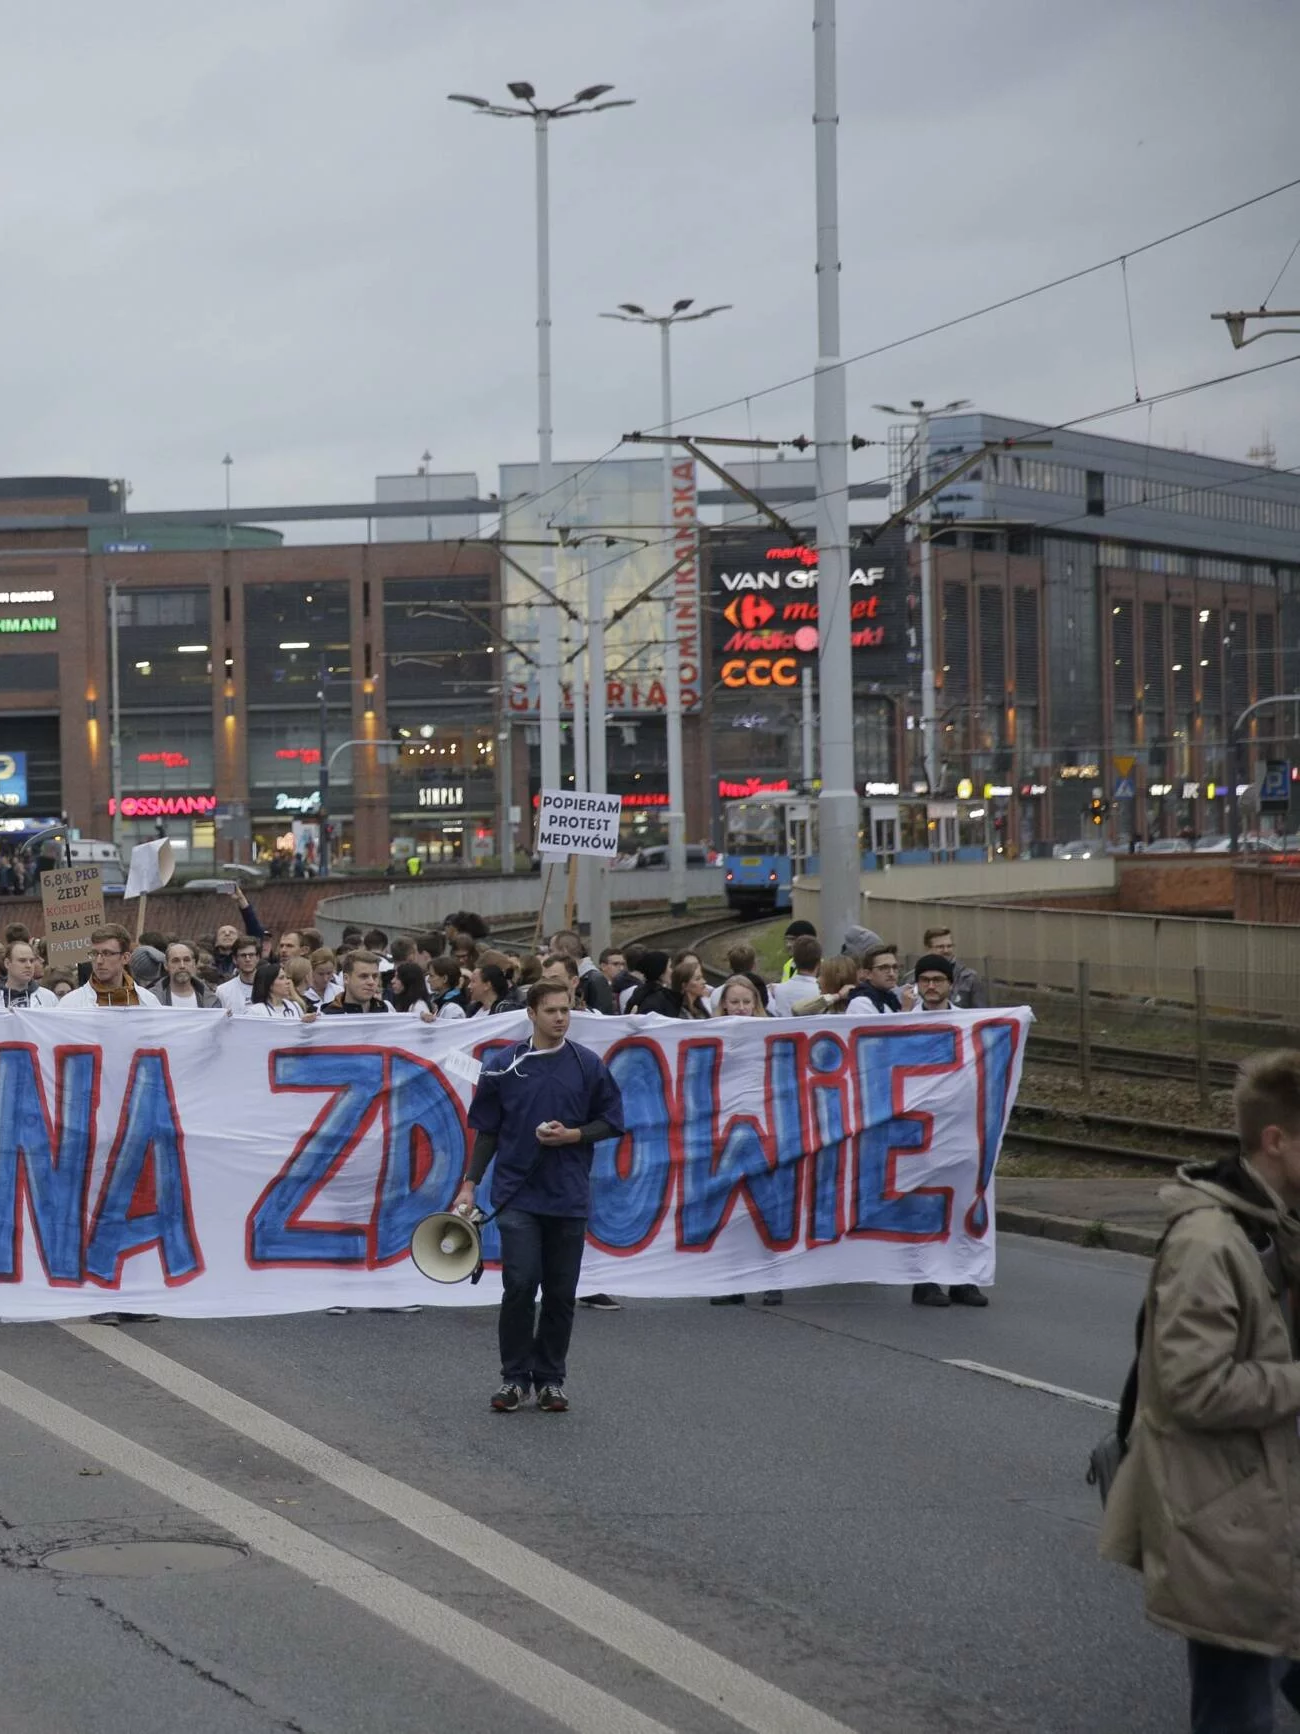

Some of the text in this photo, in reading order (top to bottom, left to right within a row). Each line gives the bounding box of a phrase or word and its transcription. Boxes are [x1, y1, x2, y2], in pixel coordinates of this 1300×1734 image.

[720, 566, 885, 590] VAN GAF
[782, 595, 880, 620] maet
[720, 657, 798, 688] CCC
[508, 679, 668, 712] GLRIA
[419, 787, 464, 806] SIMPLE
[543, 796, 621, 814] POPIERAM
[549, 814, 611, 831] PROTEST
[540, 832, 617, 849] MEDYKÓW
[43, 867, 99, 888] 6,8% PKB
[57, 884, 89, 900] ŻEBY
[45, 900, 103, 917] KOSTUCHA
[51, 914, 101, 932] BAŁA SIĘ
[50, 937, 93, 952] FARTUC
